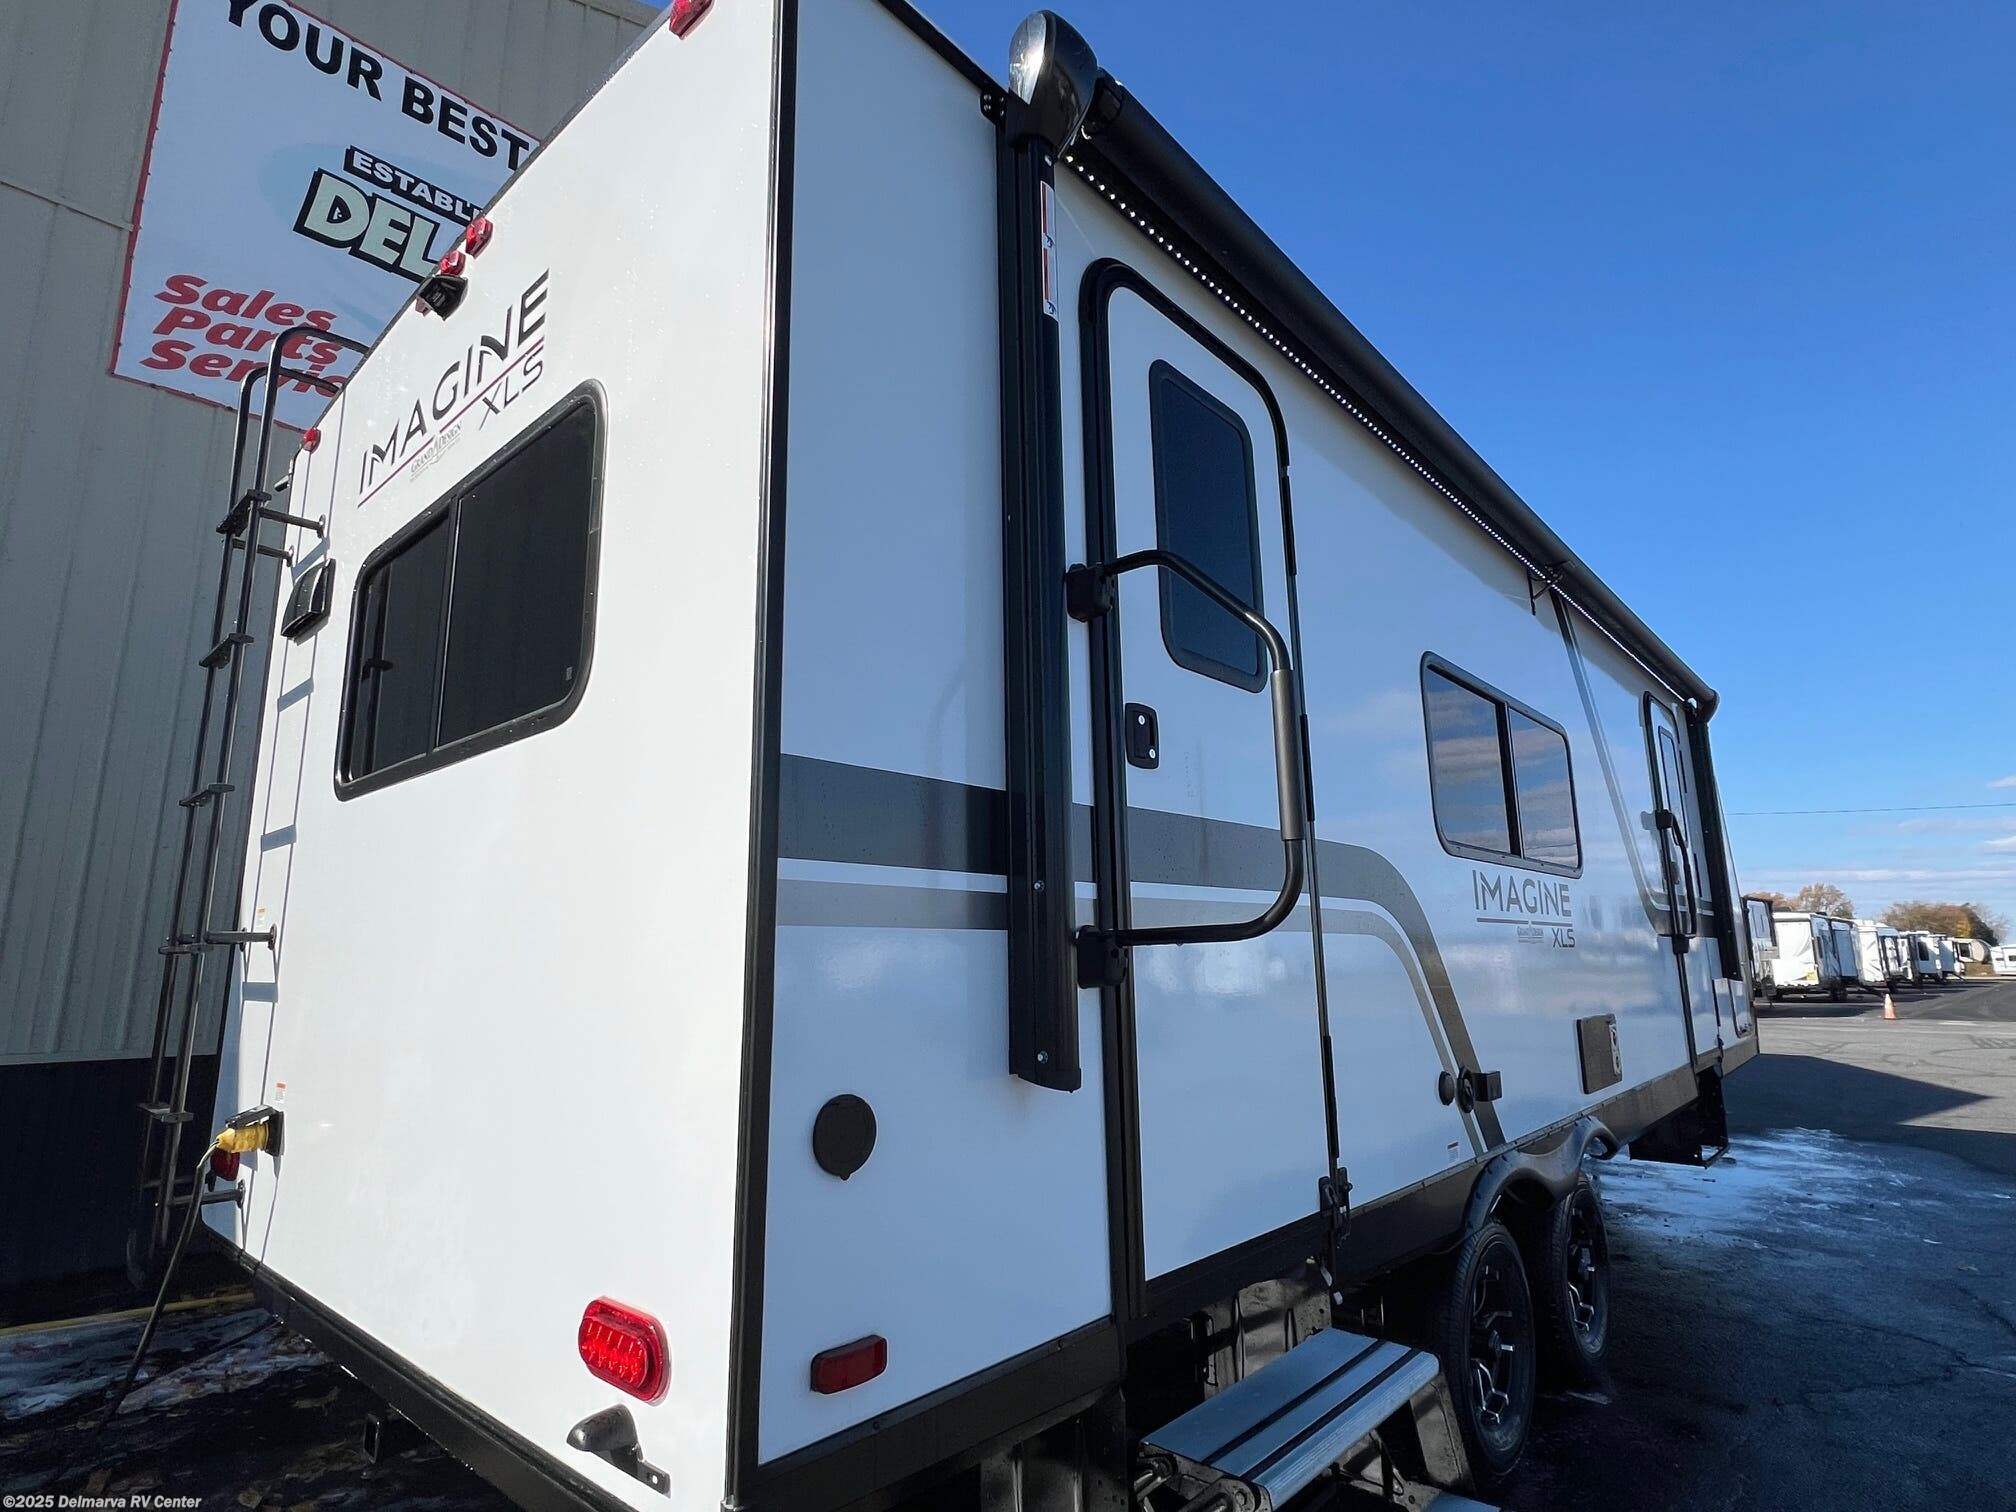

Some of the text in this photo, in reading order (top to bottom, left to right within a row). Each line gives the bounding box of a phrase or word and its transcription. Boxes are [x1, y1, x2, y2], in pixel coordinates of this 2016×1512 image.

[228, 0, 530, 171] YOUR BEST
[154, 274, 337, 331] Sales
[153, 306, 343, 364] Parts
[359, 268, 550, 494] IMAGINE
[479, 345, 544, 430] XLS
[1472, 869, 1572, 917] IMAGINE
[1552, 927, 1576, 948] XLS
